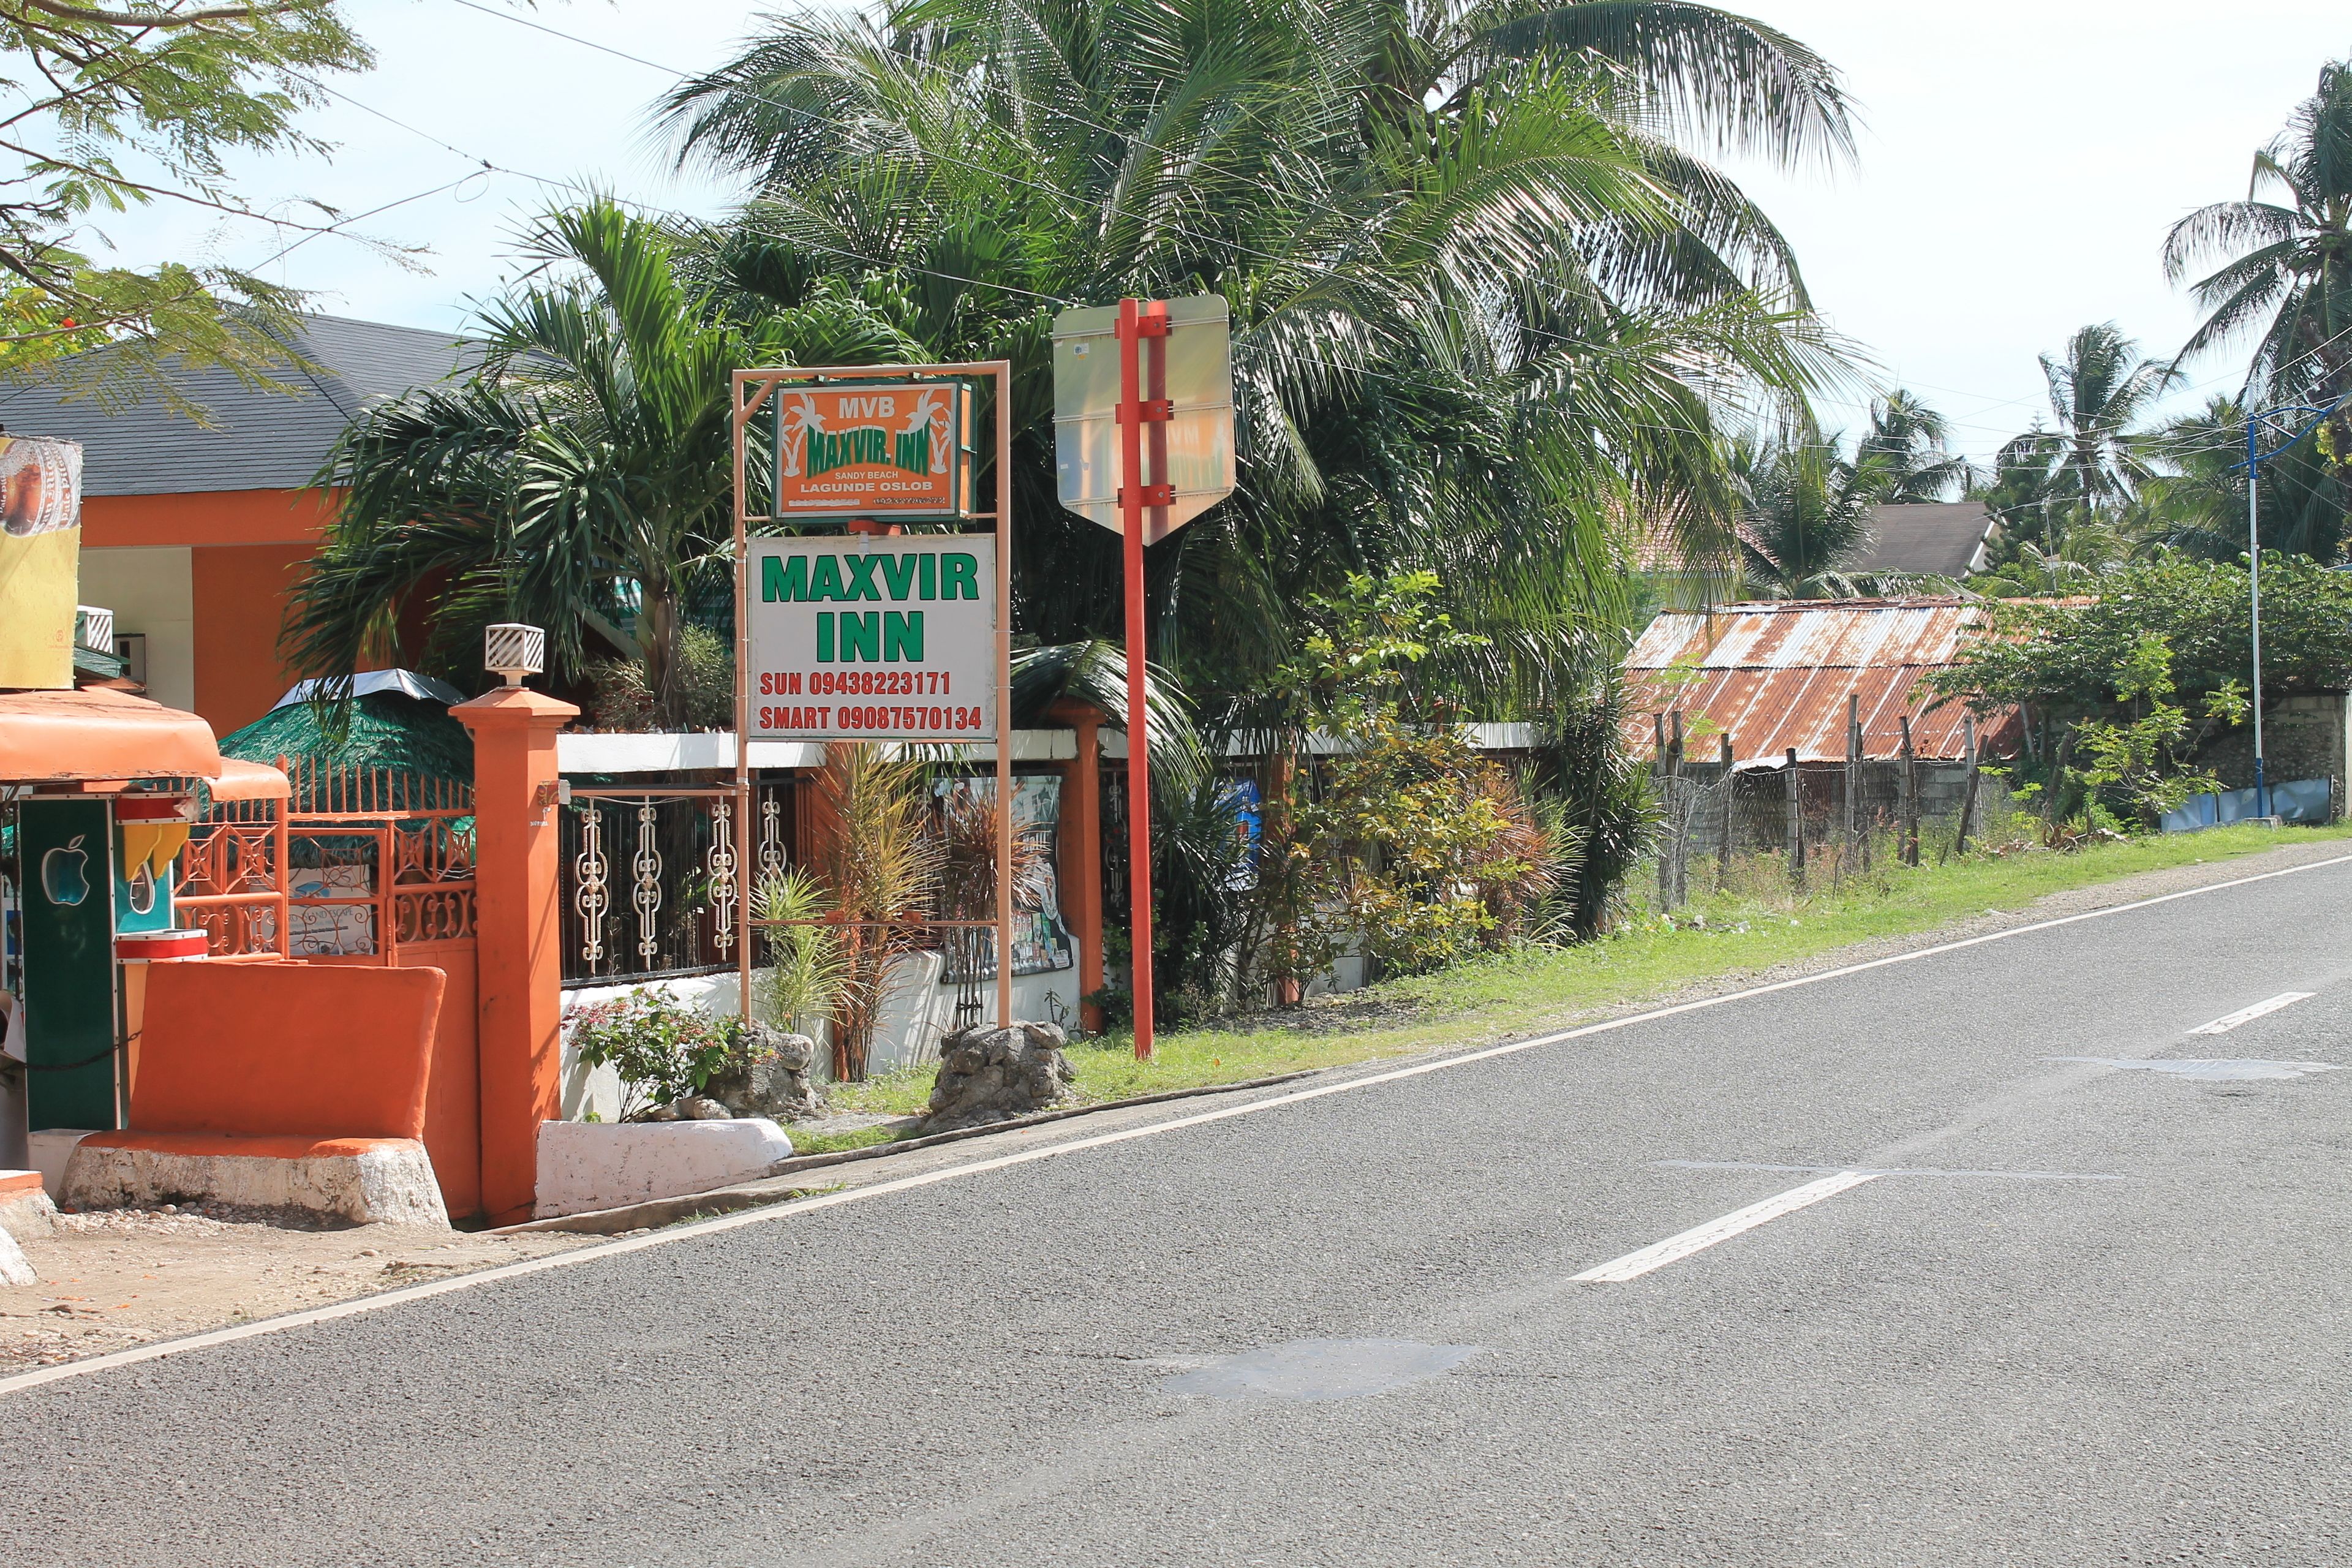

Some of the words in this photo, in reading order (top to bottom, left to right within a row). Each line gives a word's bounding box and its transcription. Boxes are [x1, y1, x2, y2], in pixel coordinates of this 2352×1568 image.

[839, 396, 895, 419] MVB
[894, 415, 930, 478] INN
[801, 483, 875, 492] LAGUNDE
[880, 481, 933, 491] OSLOB
[60, 492, 70, 521] Pale
[761, 553, 979, 602] MAXVIR
[816, 611, 924, 663] INN
[760, 673, 801, 695] SUN
[809, 671, 950, 695] 09438223171
[760, 707, 831, 729] SMART
[837, 706, 981, 729] 09087570134
[302, 911, 328, 921] SLAND
